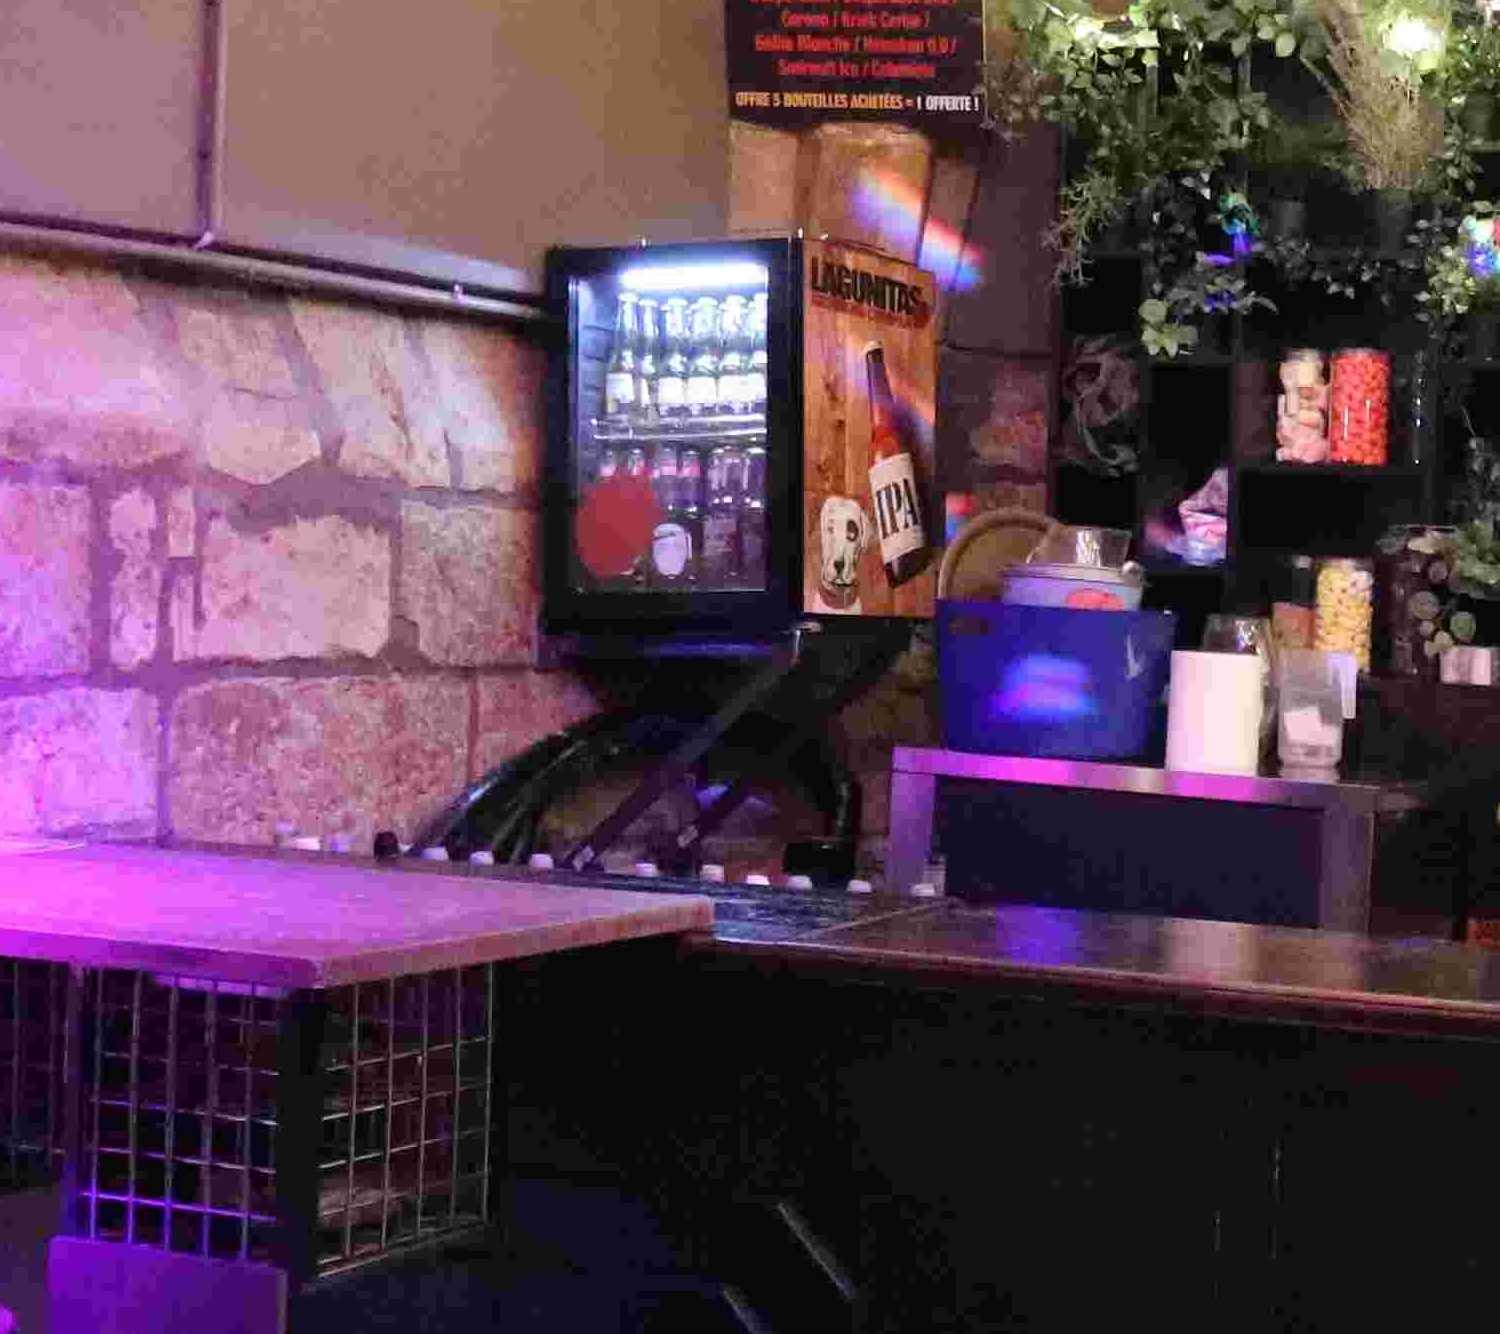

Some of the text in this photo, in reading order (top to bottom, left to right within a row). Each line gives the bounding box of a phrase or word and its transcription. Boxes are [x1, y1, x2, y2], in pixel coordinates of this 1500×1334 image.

[925, 95, 973, 112] OFFERTE
[811, 256, 923, 316] LAGUNITAS
[875, 486, 920, 540] IPA
